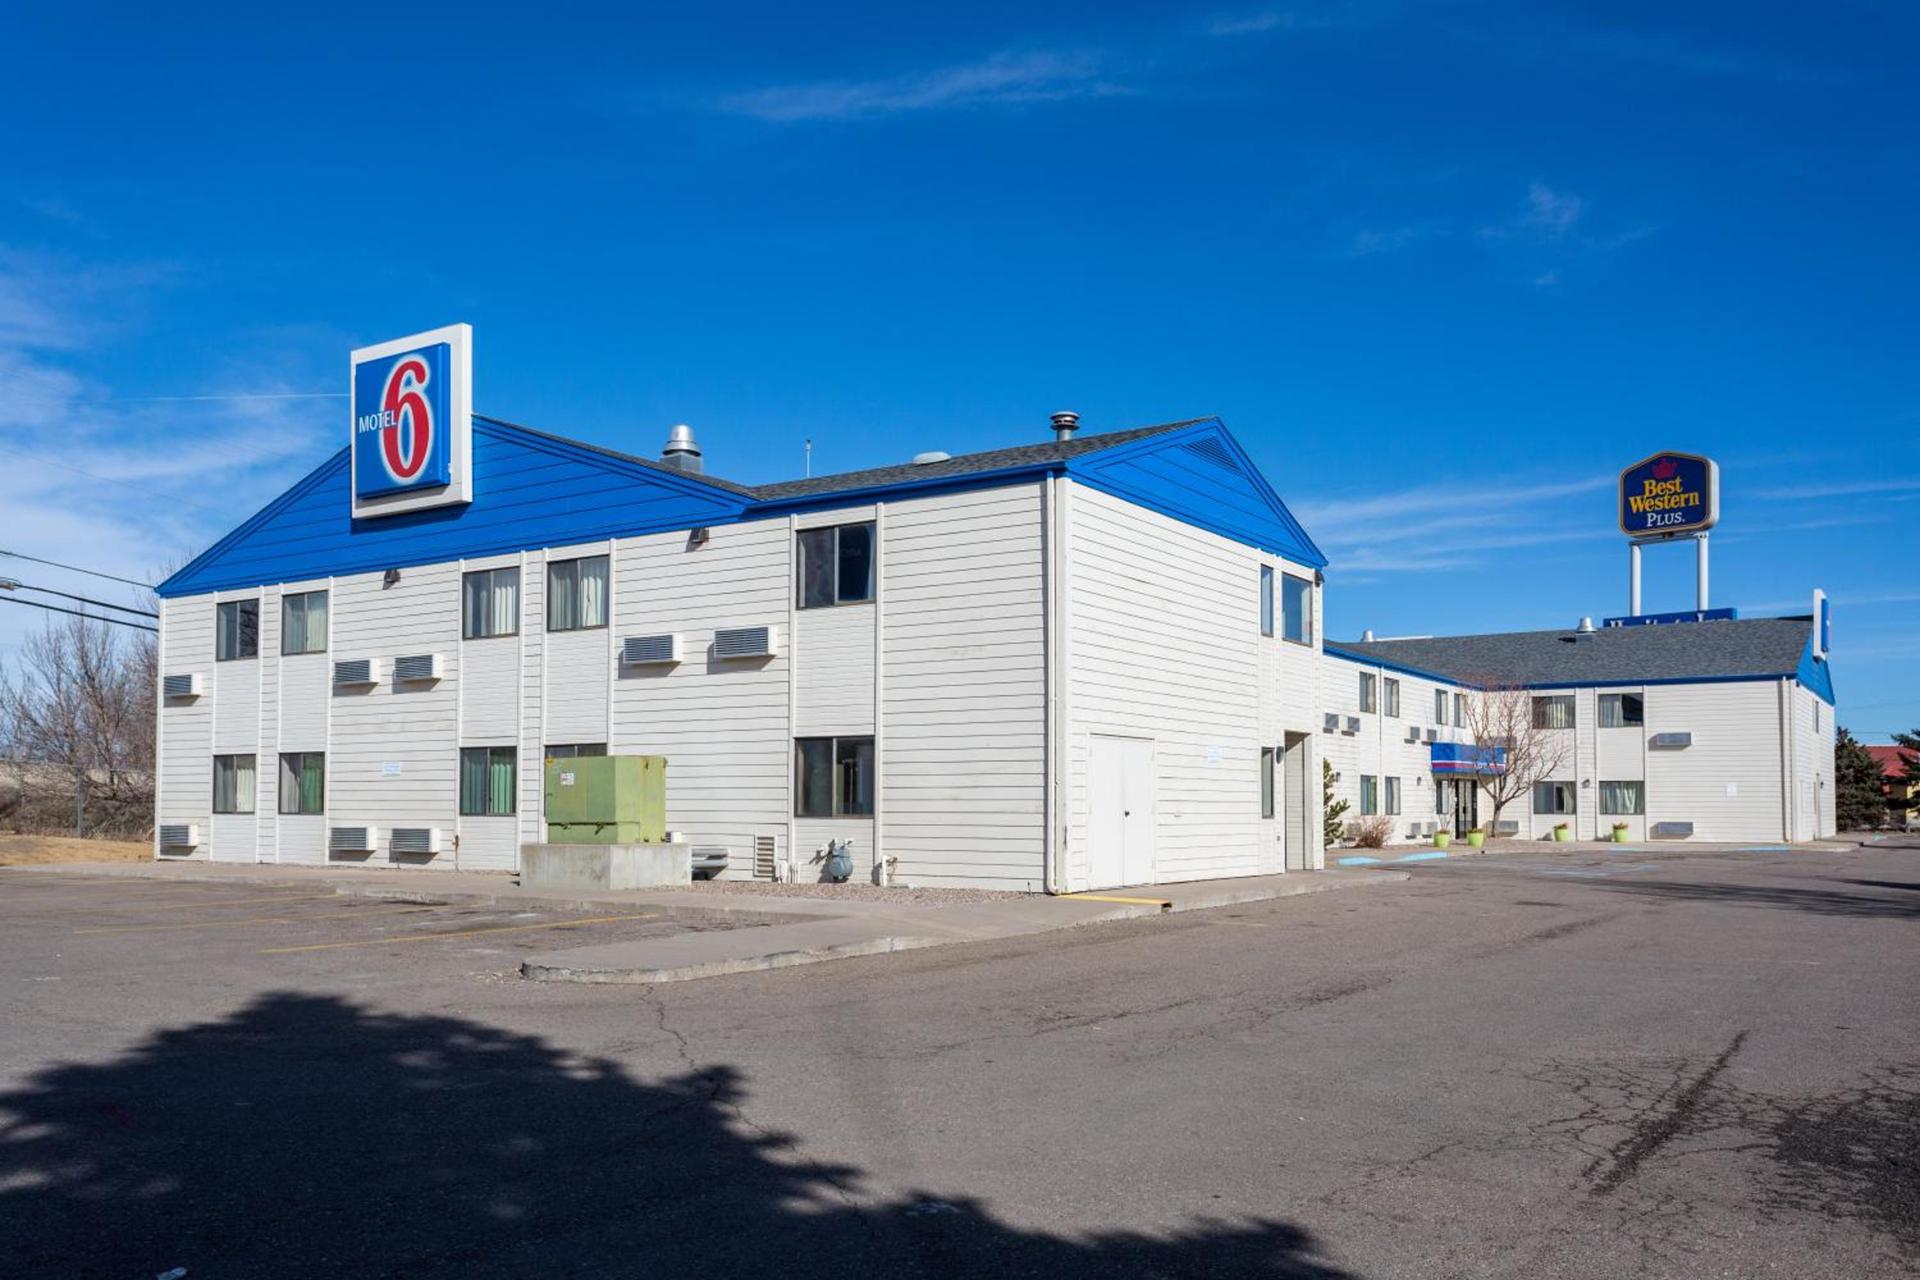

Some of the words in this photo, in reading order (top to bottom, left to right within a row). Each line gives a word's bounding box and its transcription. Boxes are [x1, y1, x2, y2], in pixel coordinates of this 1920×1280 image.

[359, 410, 397, 433] MOTEL
[380, 355, 433, 483] 6
[1643, 476, 1683, 497] Best
[1628, 491, 1700, 514] Western
